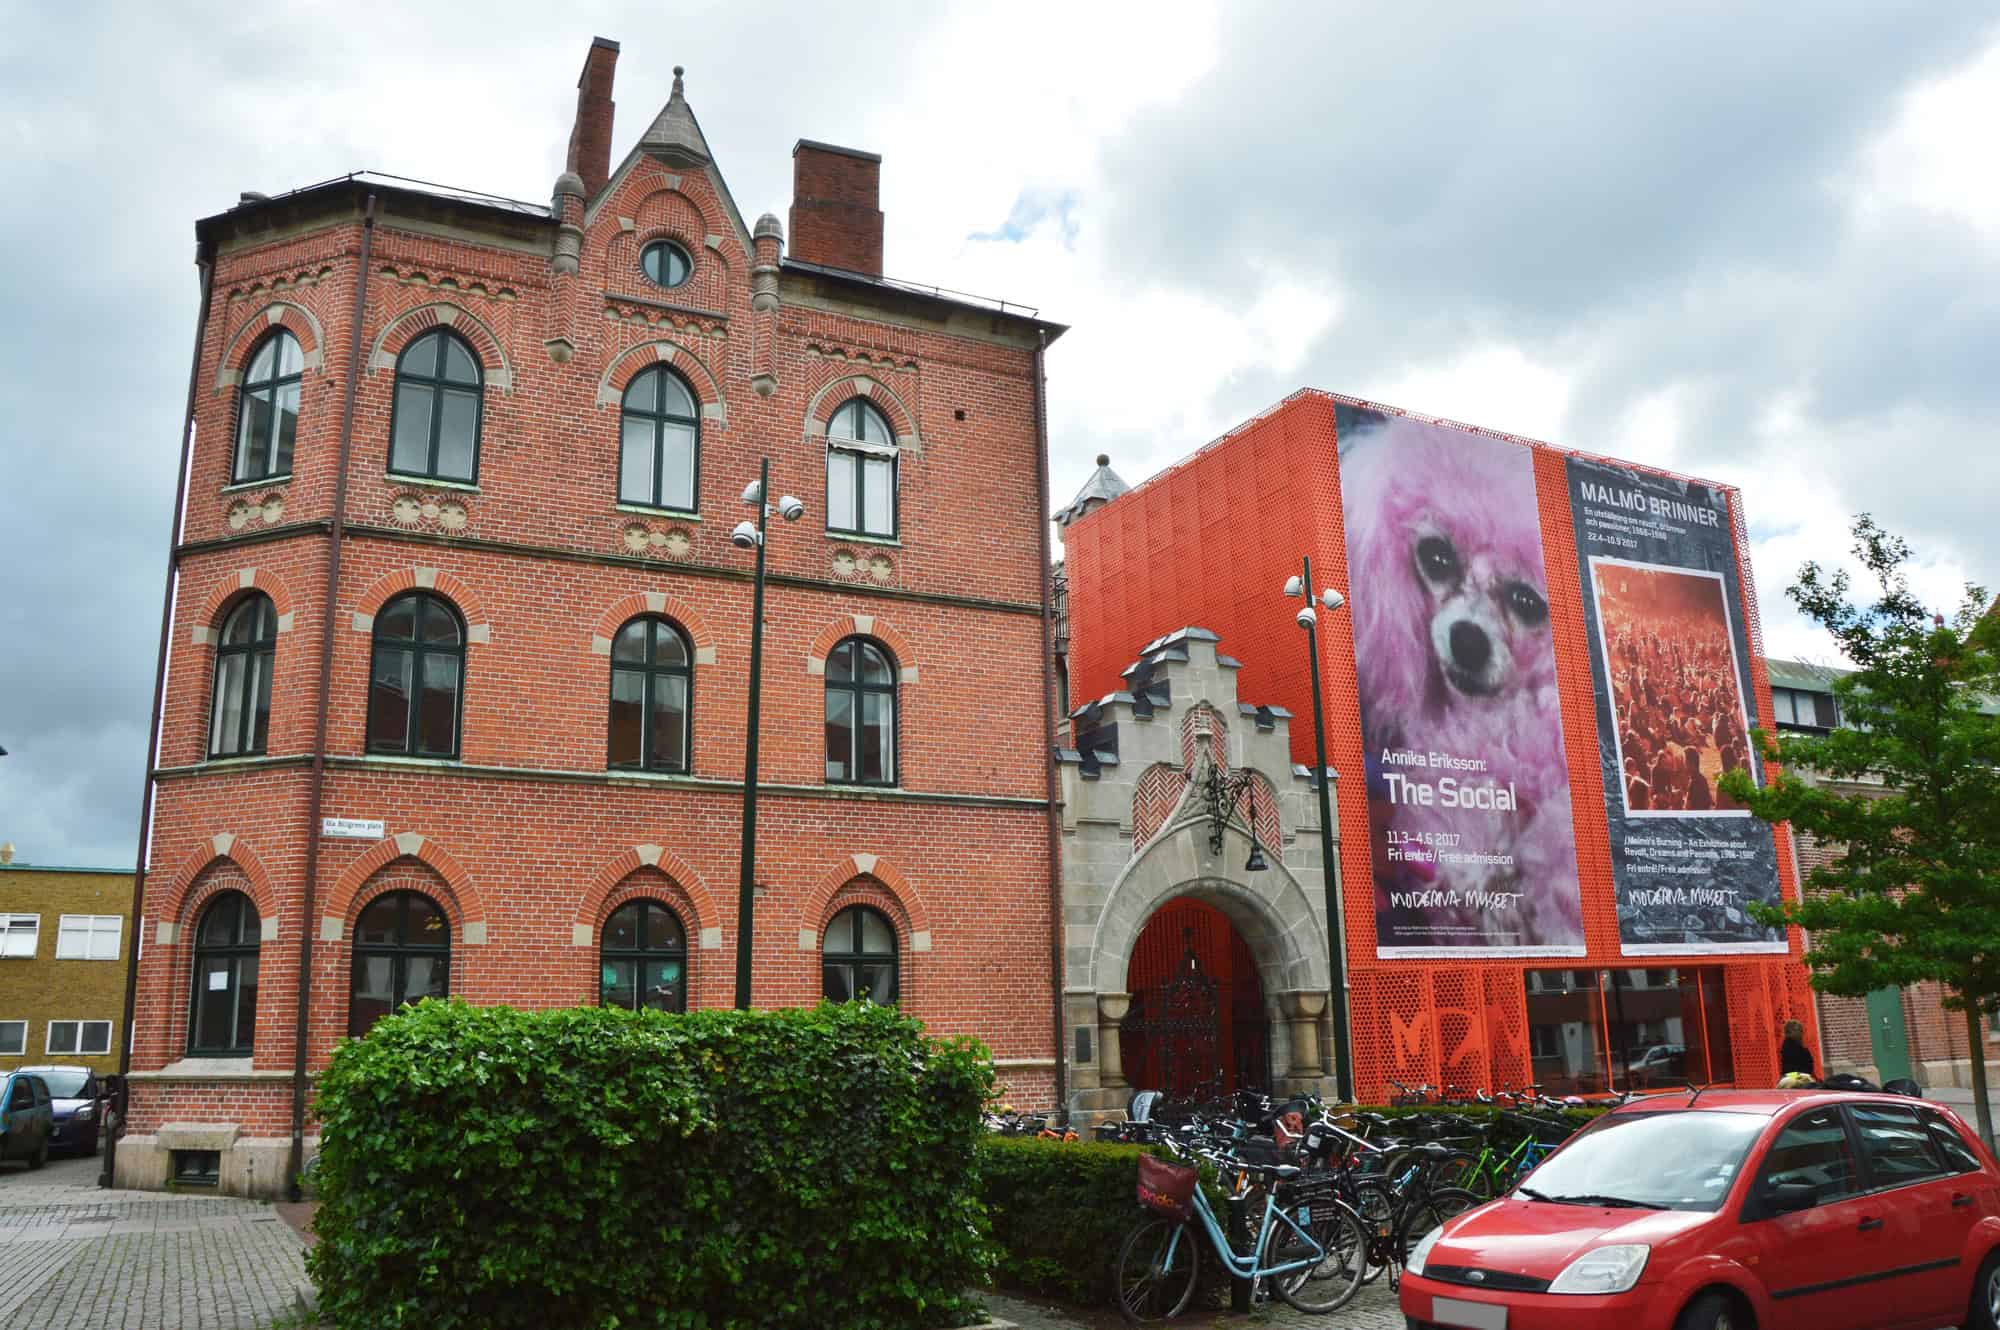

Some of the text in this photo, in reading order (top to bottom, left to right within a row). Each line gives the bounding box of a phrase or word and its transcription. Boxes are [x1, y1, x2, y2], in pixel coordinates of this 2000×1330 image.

[1580, 481, 1720, 528] MALMÖ BRINNER
[1382, 748, 1487, 772] Annika Eriksson:
[1382, 772, 1517, 811] The Social
[1435, 833, 1460, 847] 2017
[1388, 848, 1402, 862] Fri
[1463, 851, 1513, 865] admission
[1626, 863, 1638, 873] Fri
[1390, 889, 1524, 911] MODERNA MUSEET
[1628, 886, 1739, 907] MODERNA MUSEET
